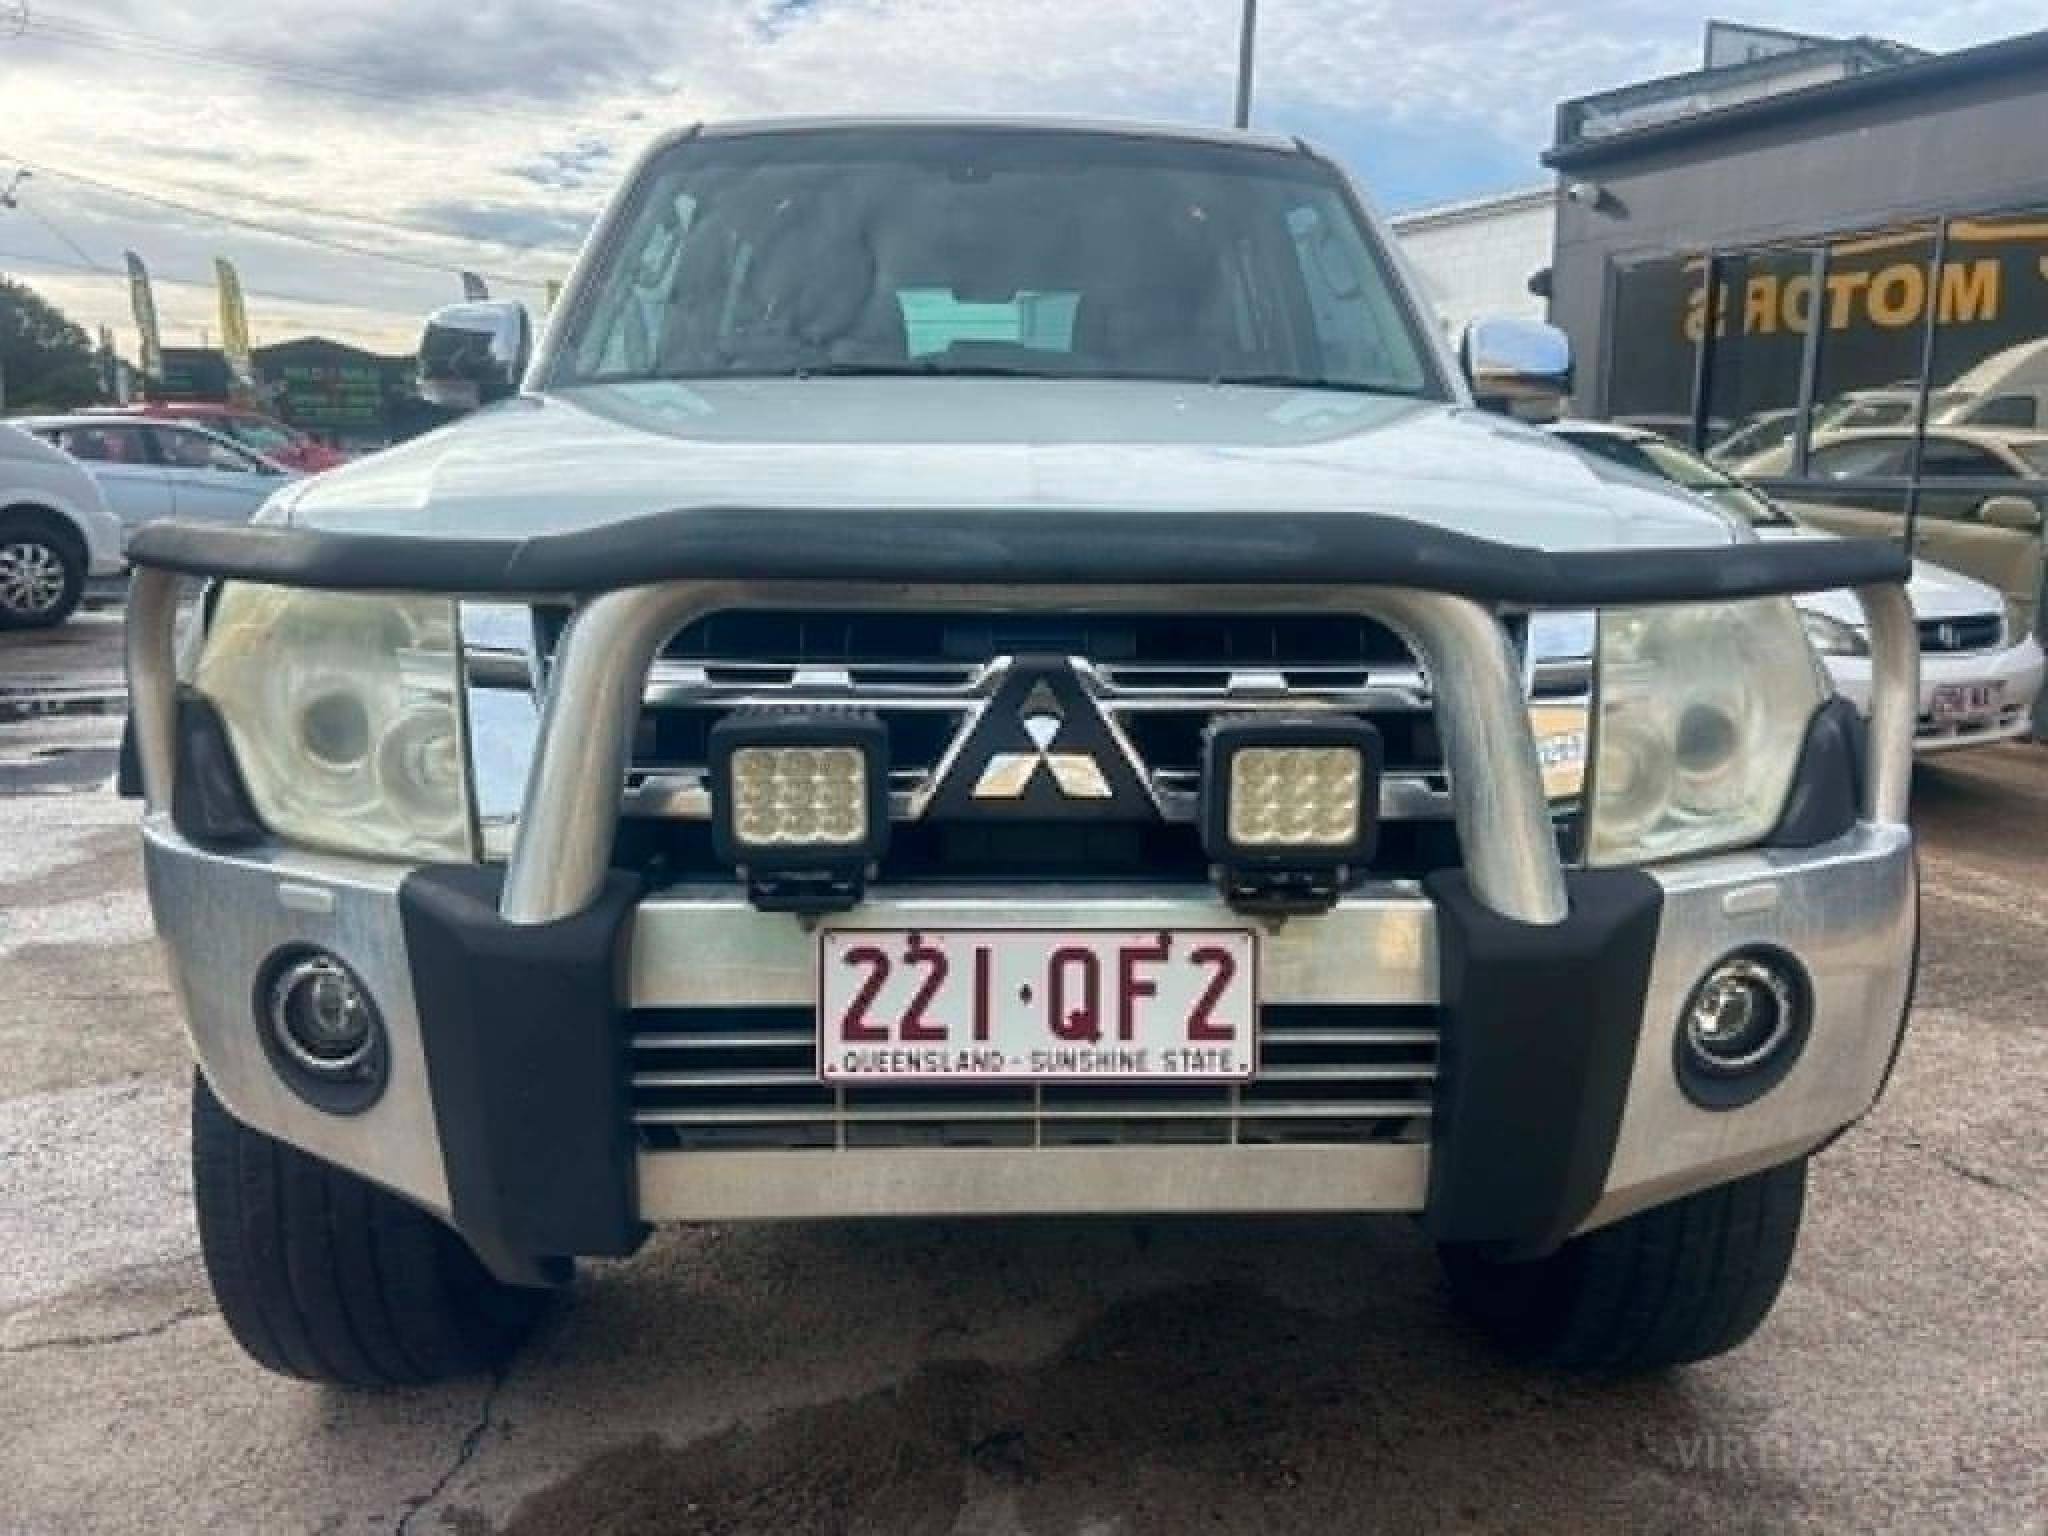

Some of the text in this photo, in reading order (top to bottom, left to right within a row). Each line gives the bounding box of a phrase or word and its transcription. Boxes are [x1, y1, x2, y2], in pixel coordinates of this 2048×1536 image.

[842, 1048, 1004, 1073] QUEENSLAND
[1028, 1048, 1147, 1073] SUNSHINE
[1164, 1048, 1234, 1073] STATE
